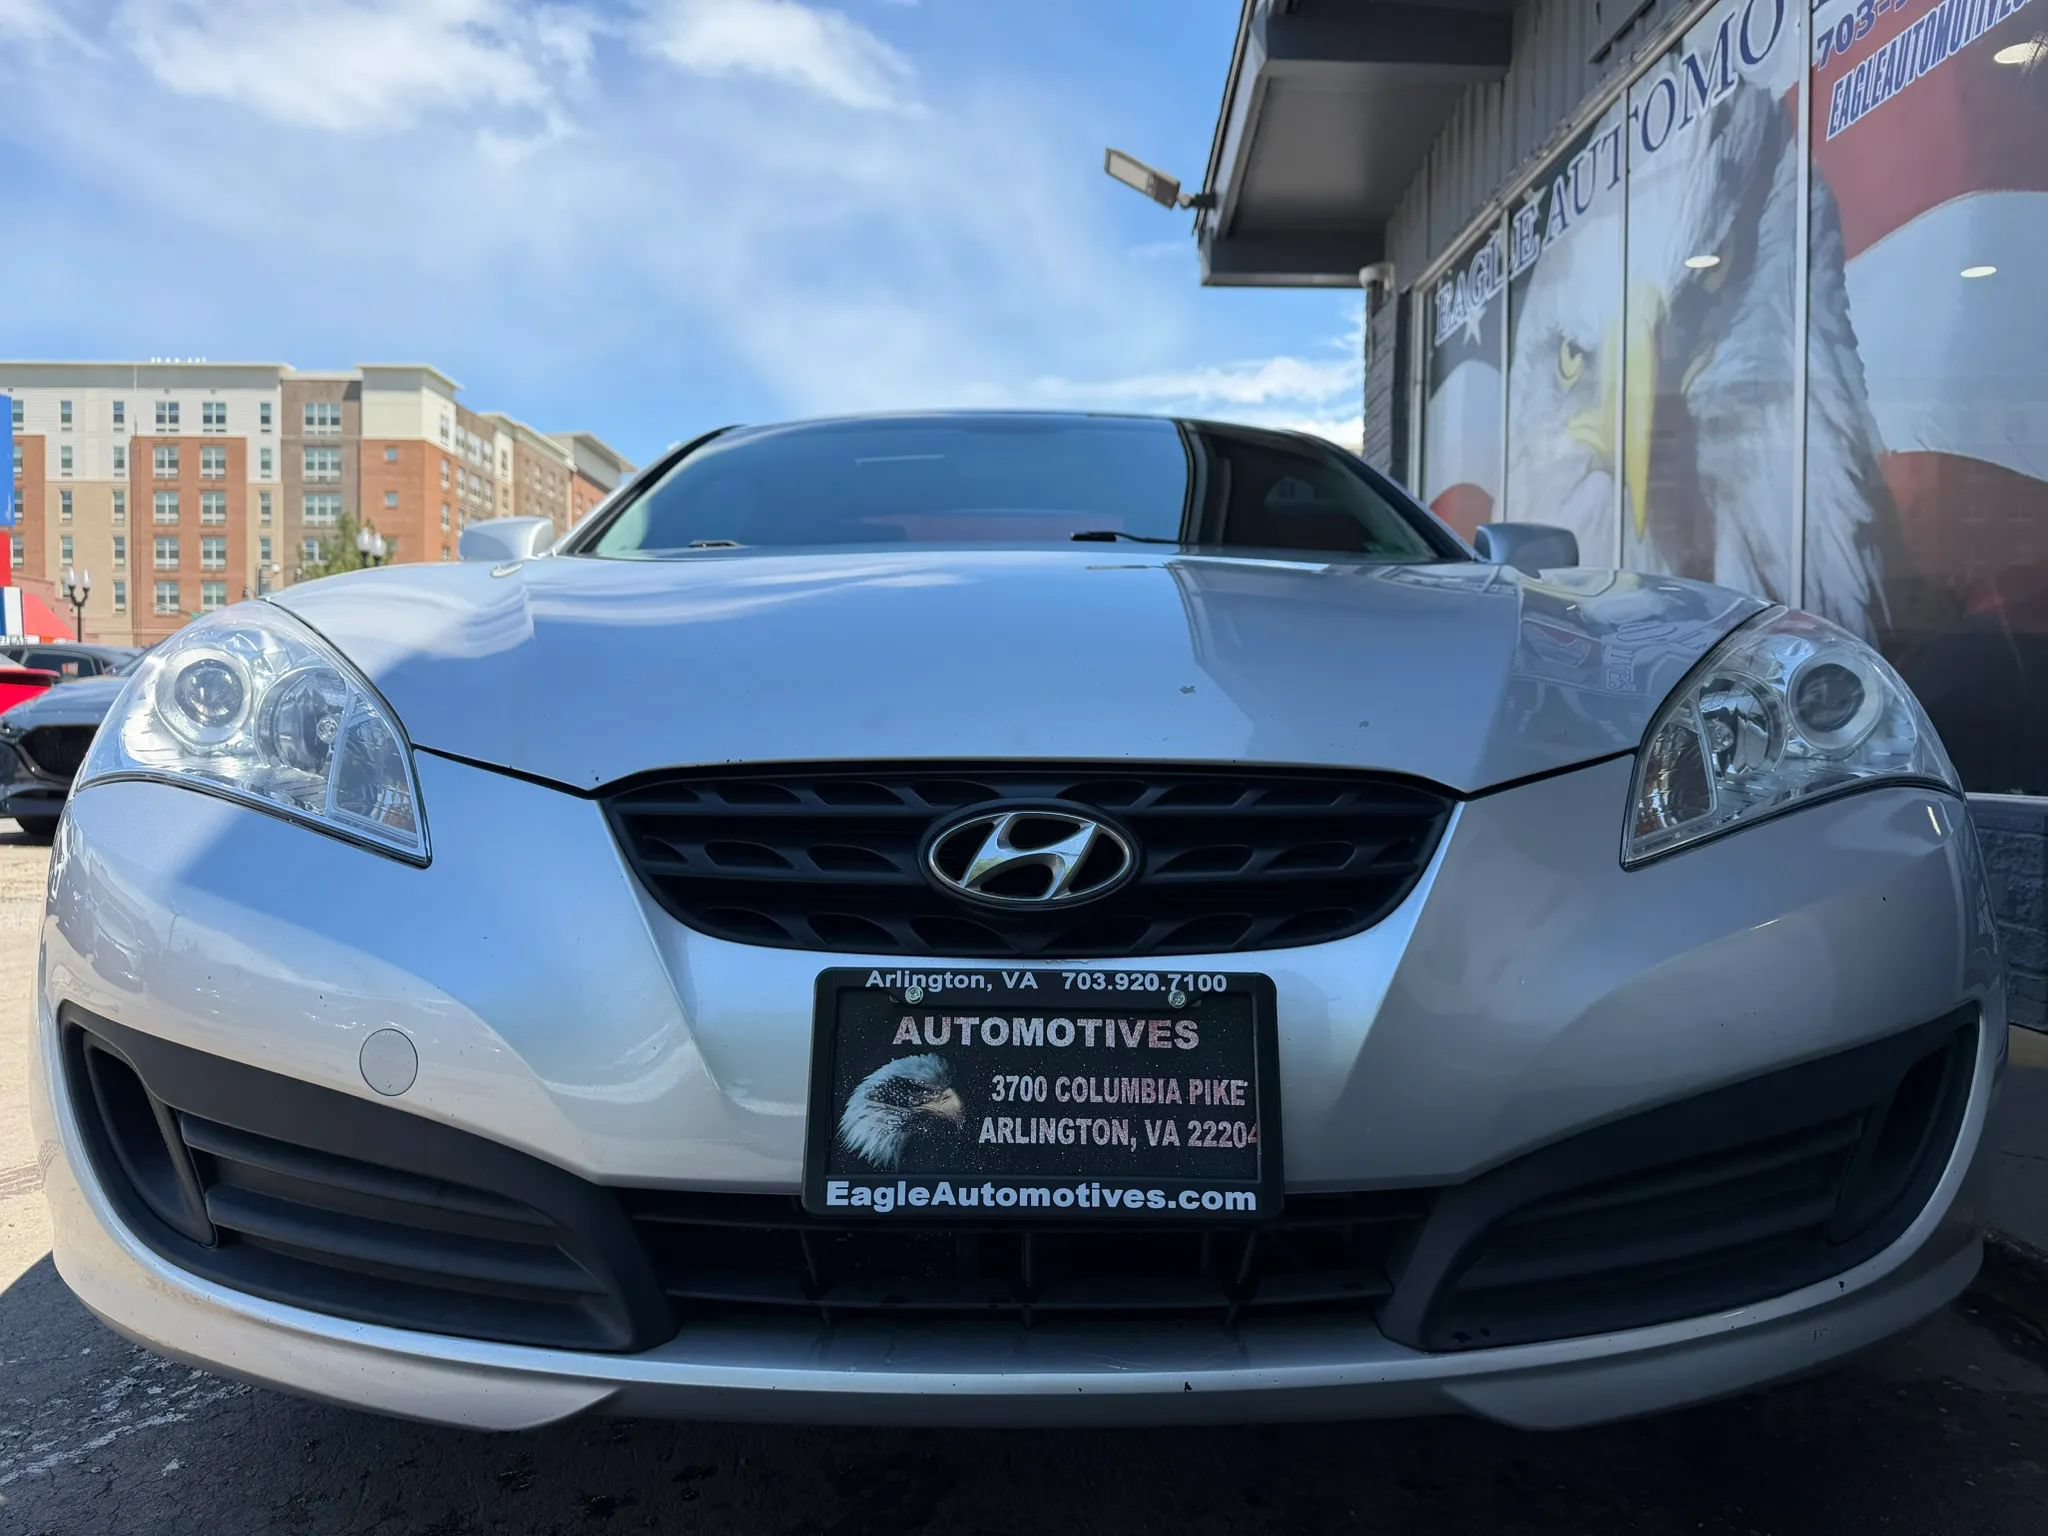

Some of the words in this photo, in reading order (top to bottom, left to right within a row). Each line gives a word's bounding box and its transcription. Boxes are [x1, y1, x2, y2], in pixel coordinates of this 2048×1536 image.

[1827, 0, 2027, 141] EAGLEAUTOMOTIV
[1435, 203, 1543, 346] EAGLE
[1543, 0, 1800, 248] AUTOMO
[865, 970, 993, 992] Arlington,
[1001, 971, 1038, 989] VA
[1062, 972, 1227, 992] 703.920.7100
[892, 1016, 1200, 1049] AUTOMOTIVES
[991, 1075, 1047, 1102] 3700
[1055, 1077, 1182, 1104] COLUMBIA
[1189, 1079, 1248, 1106] PIKE
[978, 1117, 1137, 1152] ARLINGTON,
[1144, 1119, 1180, 1146] VA
[1187, 1121, 1259, 1148] 22204
[826, 1181, 1257, 1213] EagleAutomotives.com
